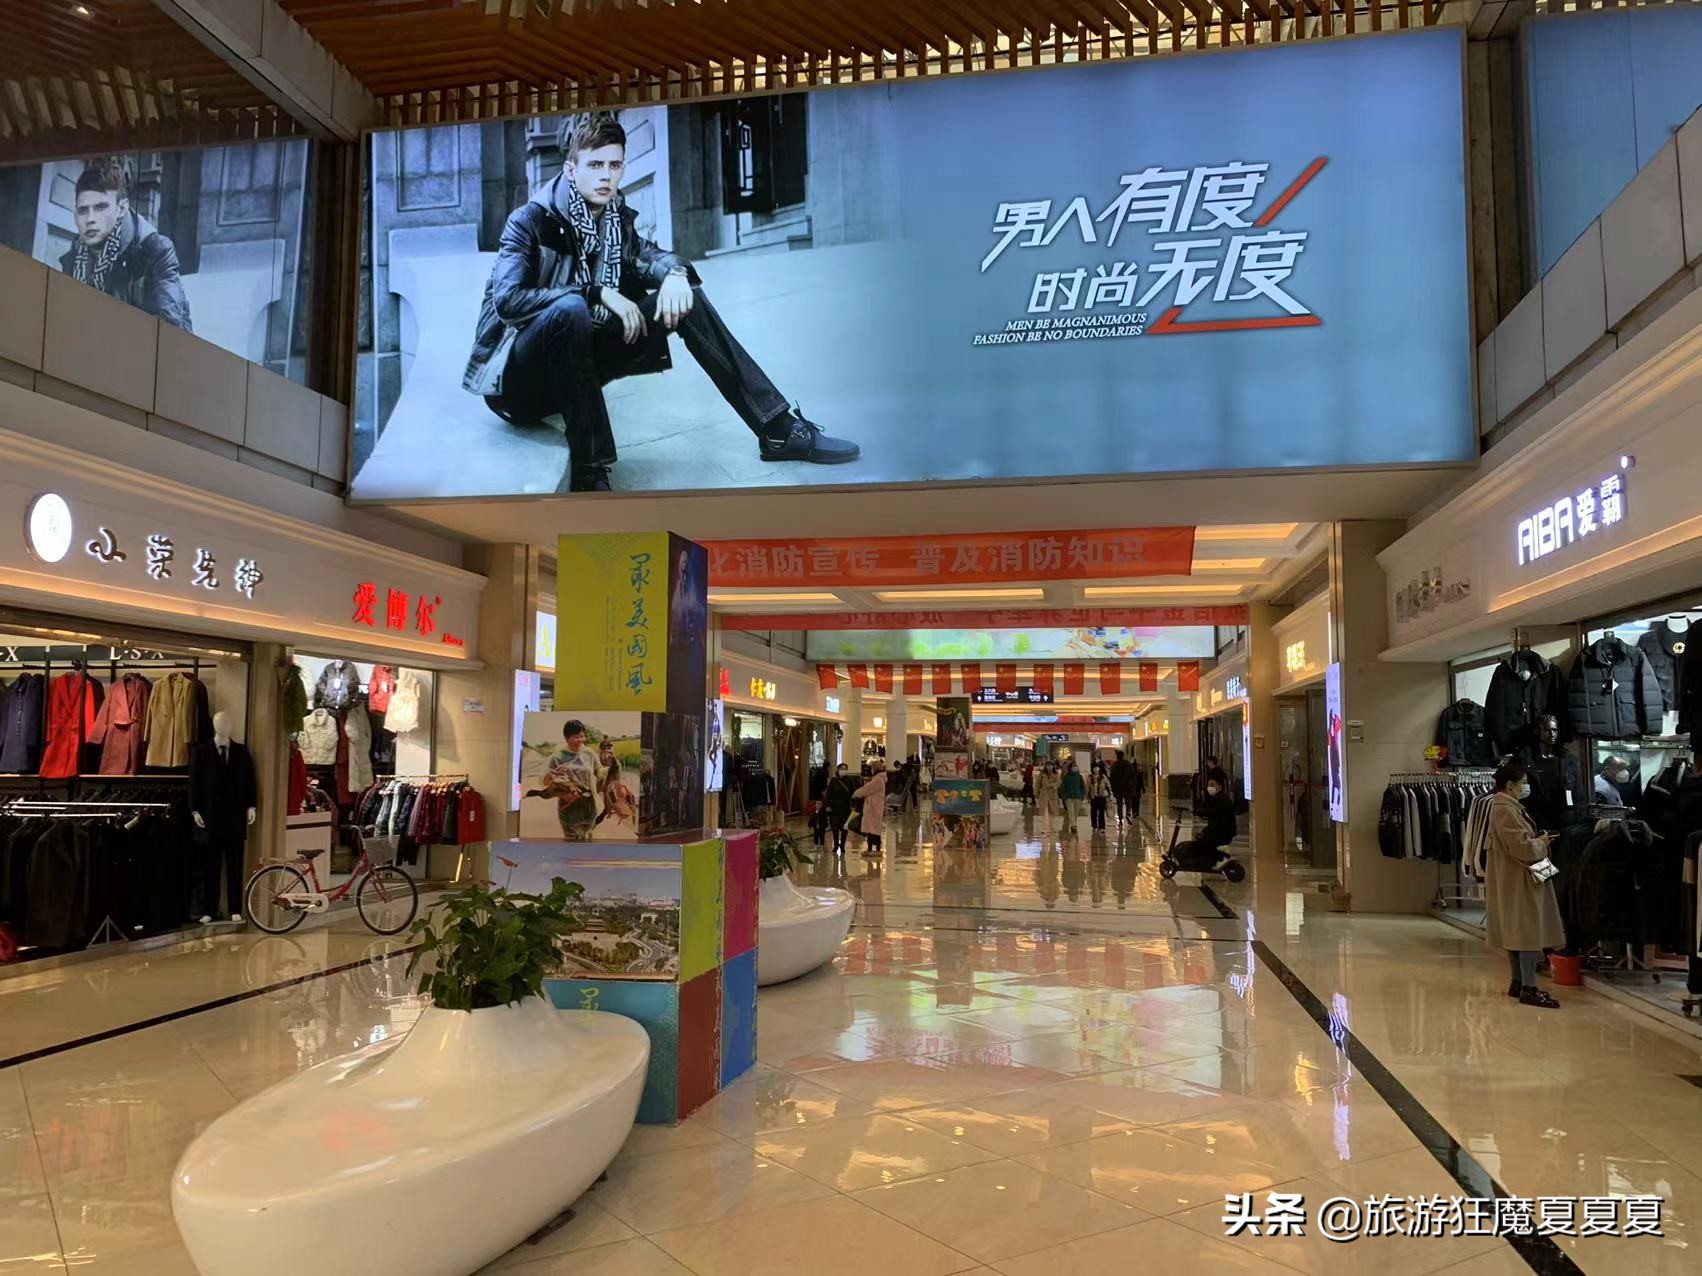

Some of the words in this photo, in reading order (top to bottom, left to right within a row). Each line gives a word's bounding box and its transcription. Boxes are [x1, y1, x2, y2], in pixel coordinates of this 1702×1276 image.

[981, 162, 1269, 272] 男人有度
[1027, 231, 1311, 315] 时尚无度
[973, 332, 1025, 345] FASHION
[1027, 331, 1042, 341] BE
[1043, 330, 1062, 340] NO
[1064, 325, 1143, 339] BOUNDARIES
[1005, 320, 1034, 331] MEN
[1035, 319, 1050, 329] BE
[1052, 313, 1147, 328] MAGNANIMOUS
[911, 535, 1146, 575] 普及消防知识
